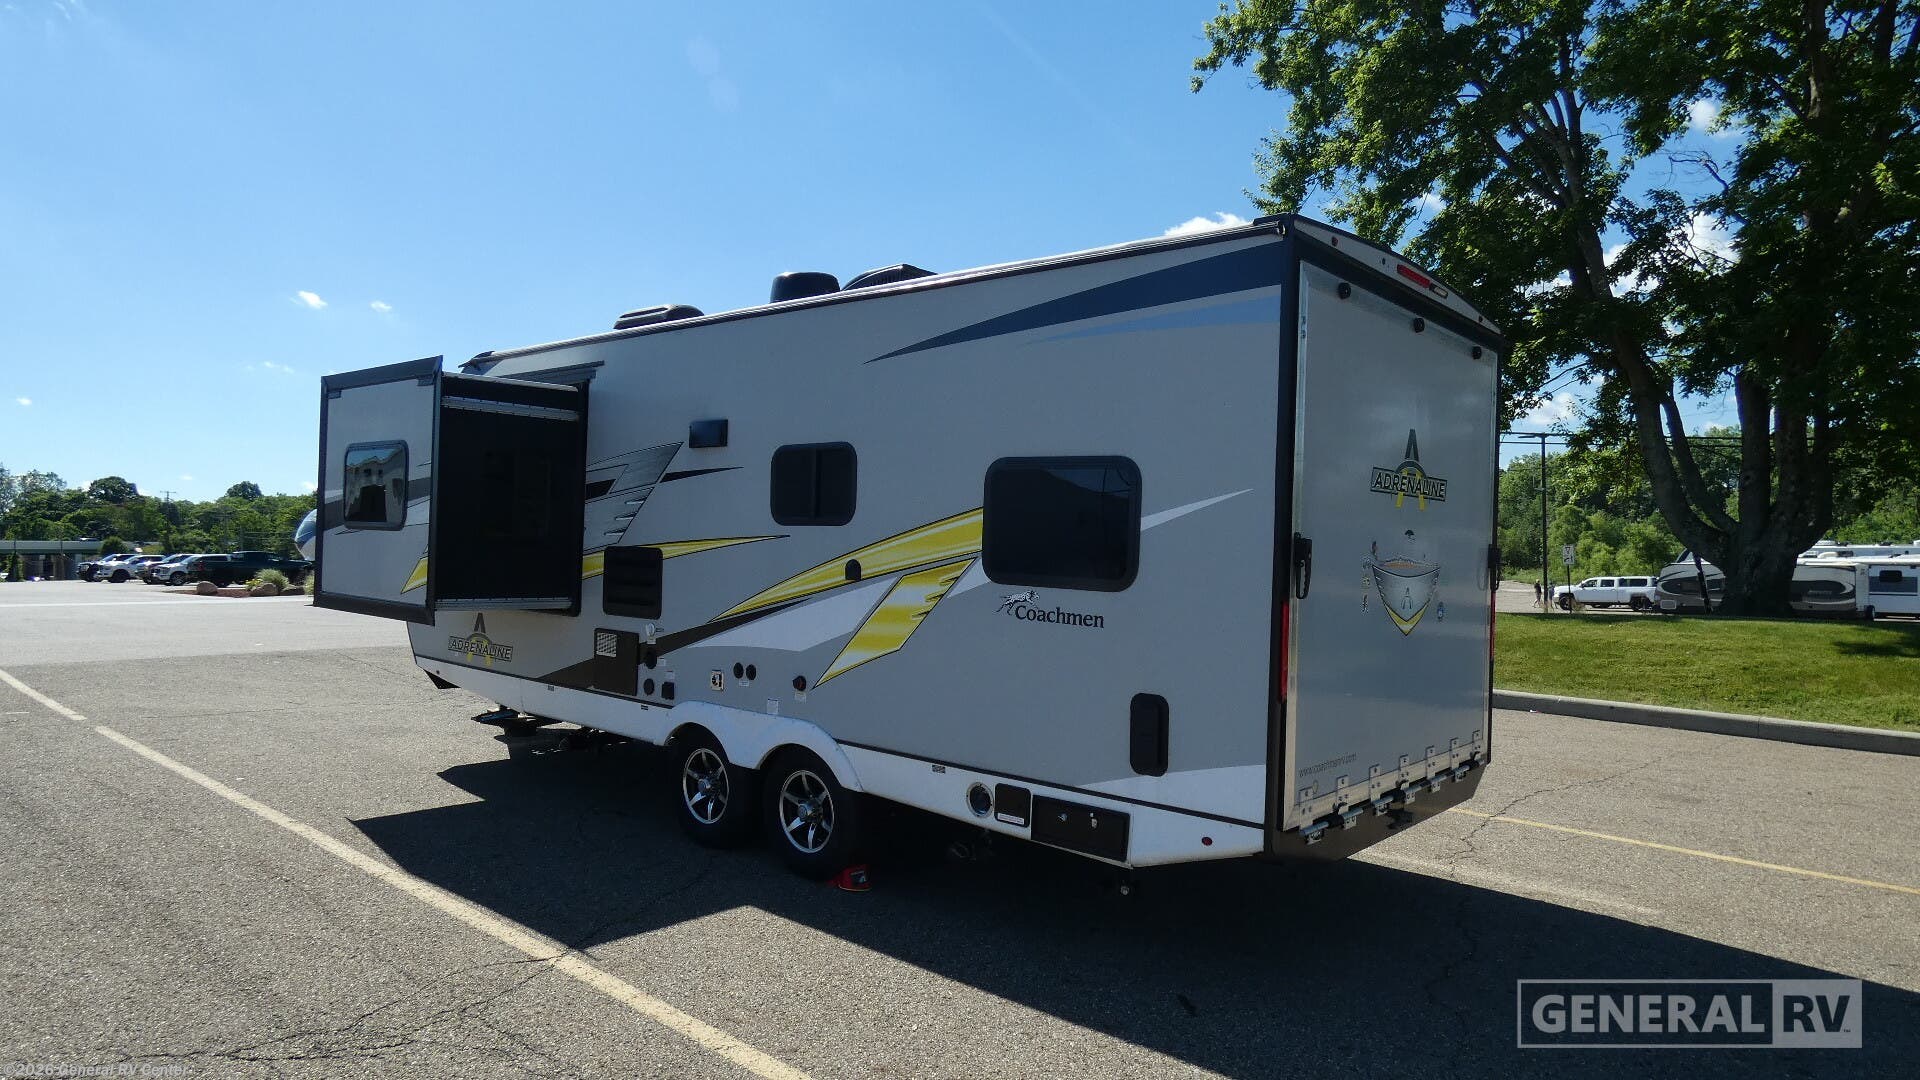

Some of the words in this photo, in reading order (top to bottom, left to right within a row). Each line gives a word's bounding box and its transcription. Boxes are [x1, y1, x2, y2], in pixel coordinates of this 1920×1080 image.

[1373, 471, 1445, 498] ADRENALINE
[1015, 605, 1104, 628] Coachmen
[450, 639, 512, 659] ADRENALINE
